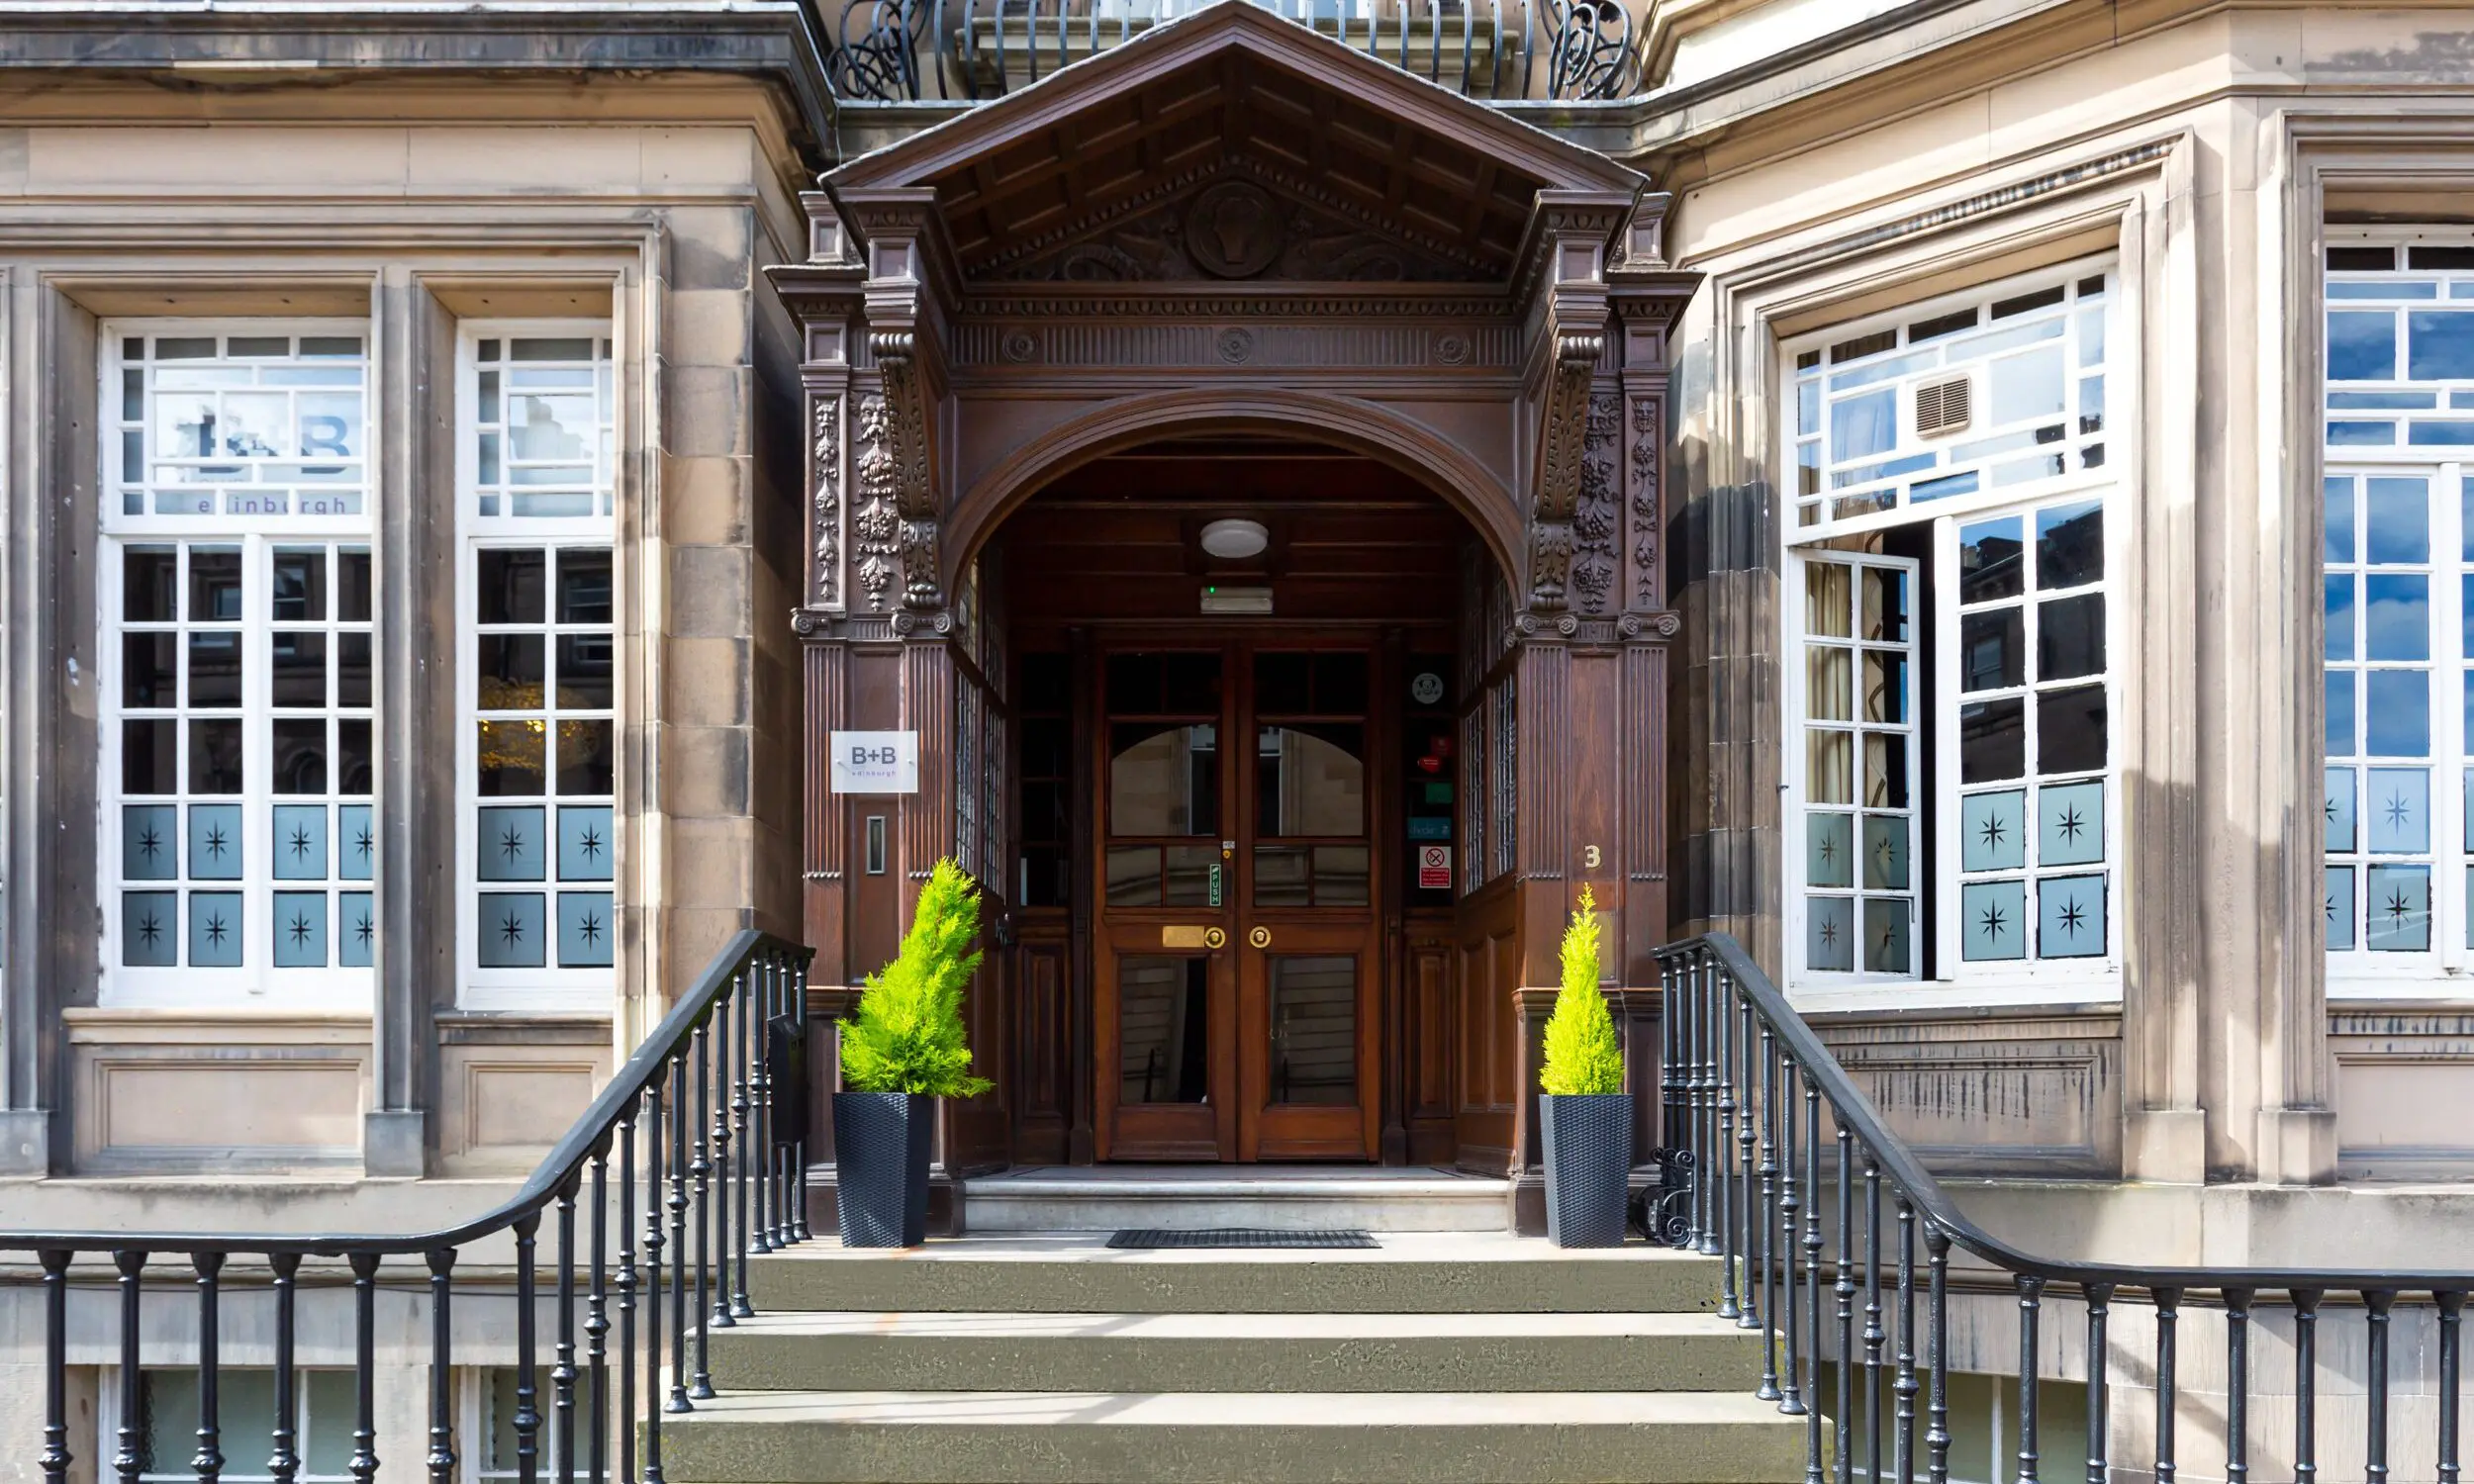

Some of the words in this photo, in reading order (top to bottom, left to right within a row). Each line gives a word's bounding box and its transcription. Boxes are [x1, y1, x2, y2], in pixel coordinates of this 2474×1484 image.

[199, 498, 345, 514] einbrgh
[852, 746, 897, 765] B+B
[1584, 845, 1601, 868] 3
